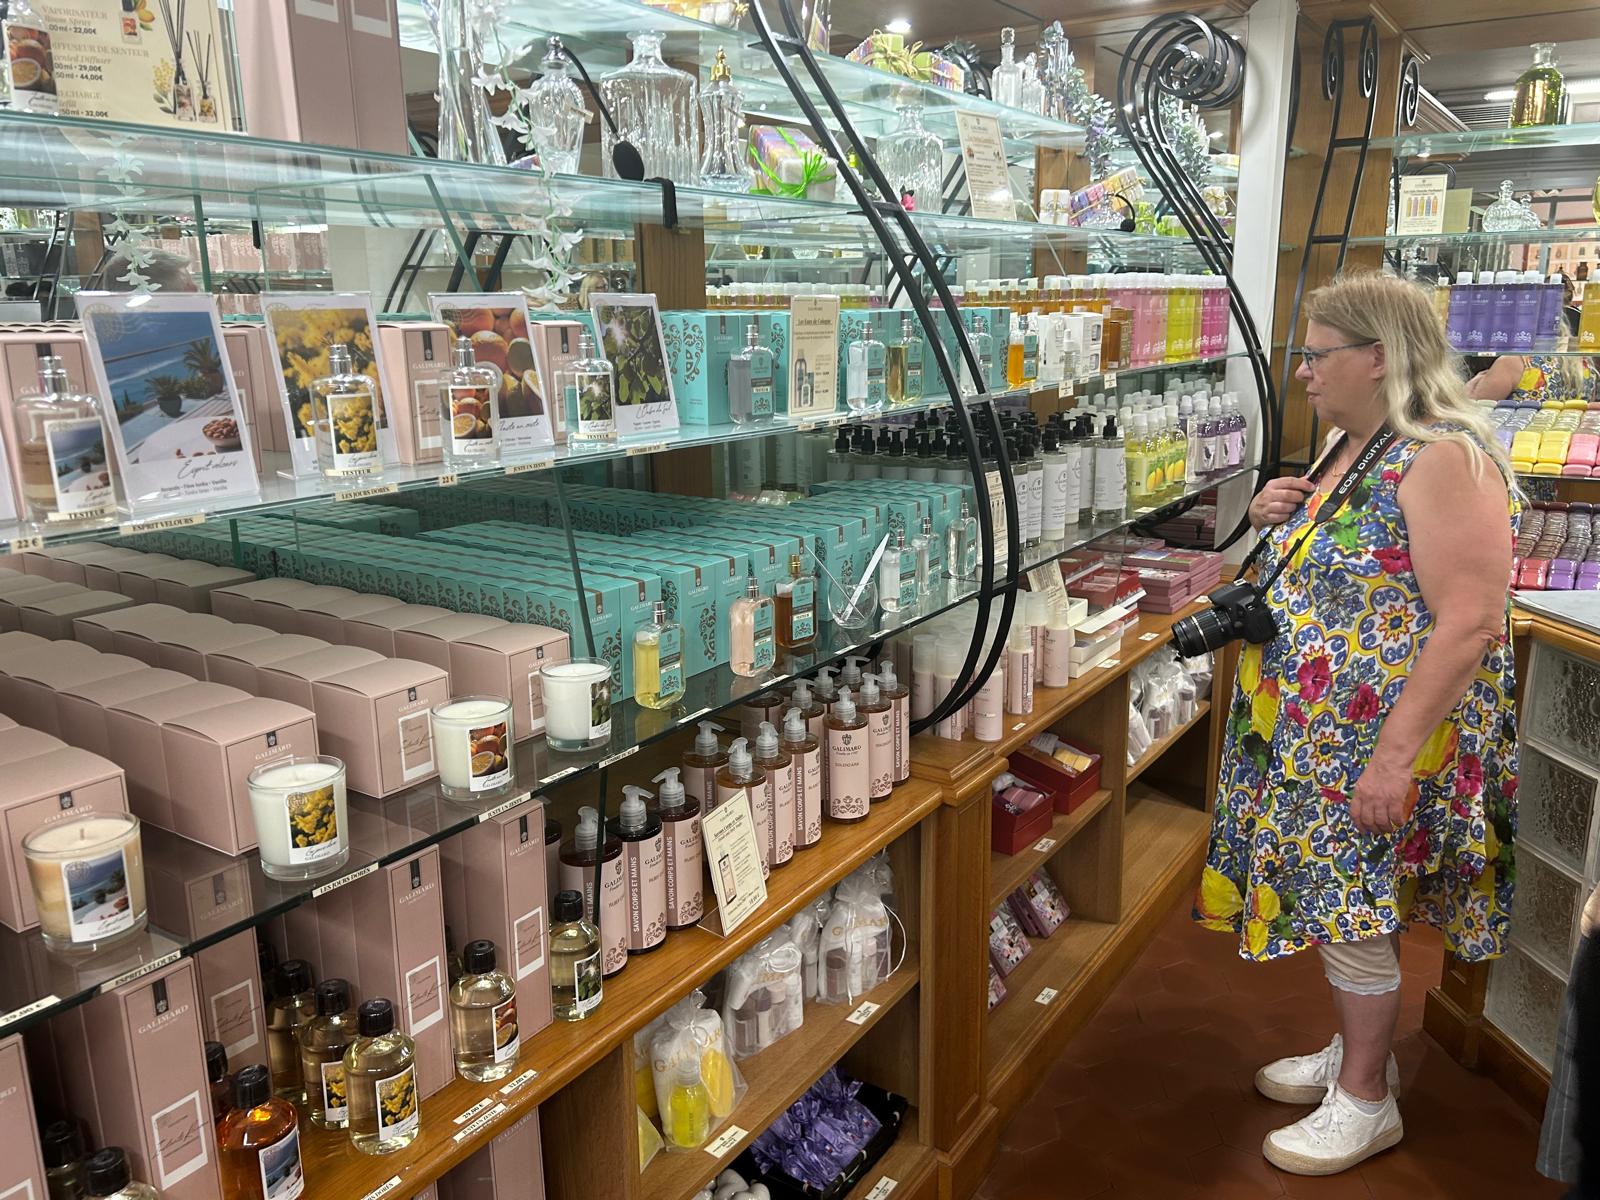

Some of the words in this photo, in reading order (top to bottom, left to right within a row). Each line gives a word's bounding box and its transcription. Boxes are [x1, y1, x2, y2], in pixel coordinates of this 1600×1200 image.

[52, 42, 96, 53] IFFUSEUR
[1338, 472, 1358, 494] EOS
[1357, 431, 1394, 471] DIGITAL
[342, 468, 371, 476] TESTEUR
[442, 476, 449, 484] 22
[341, 492, 353, 500] LES
[353, 489, 370, 499] JOURS
[370, 486, 390, 496] DORÉS
[67, 508, 105, 520] TESTEUR
[132, 523, 160, 532] ESPRIT
[159, 517, 194, 529] VELOURS
[16, 539, 30, 549] 22
[31, 538, 39, 547] €
[255, 743, 292, 760] GALIMARD
[44, 804, 93, 824] GALIMARD
[665, 836, 673, 857] MAINS
[666, 858, 673, 867] ET
[320, 884, 332, 894] LES
[332, 876, 351, 890] JOURS
[351, 868, 371, 880] DORÉS
[631, 877, 638, 887] ET
[399, 882, 435, 904] GALIMARD
[631, 888, 639, 912] CORPS
[668, 891, 676, 910] SAVON
[632, 913, 640, 932] SAVON
[114, 969, 143, 986] ESPRIT
[143, 953, 179, 974] VELOURS
[137, 1003, 190, 1036] GALIMARD
[374, 1182, 394, 1198] DORÉS
